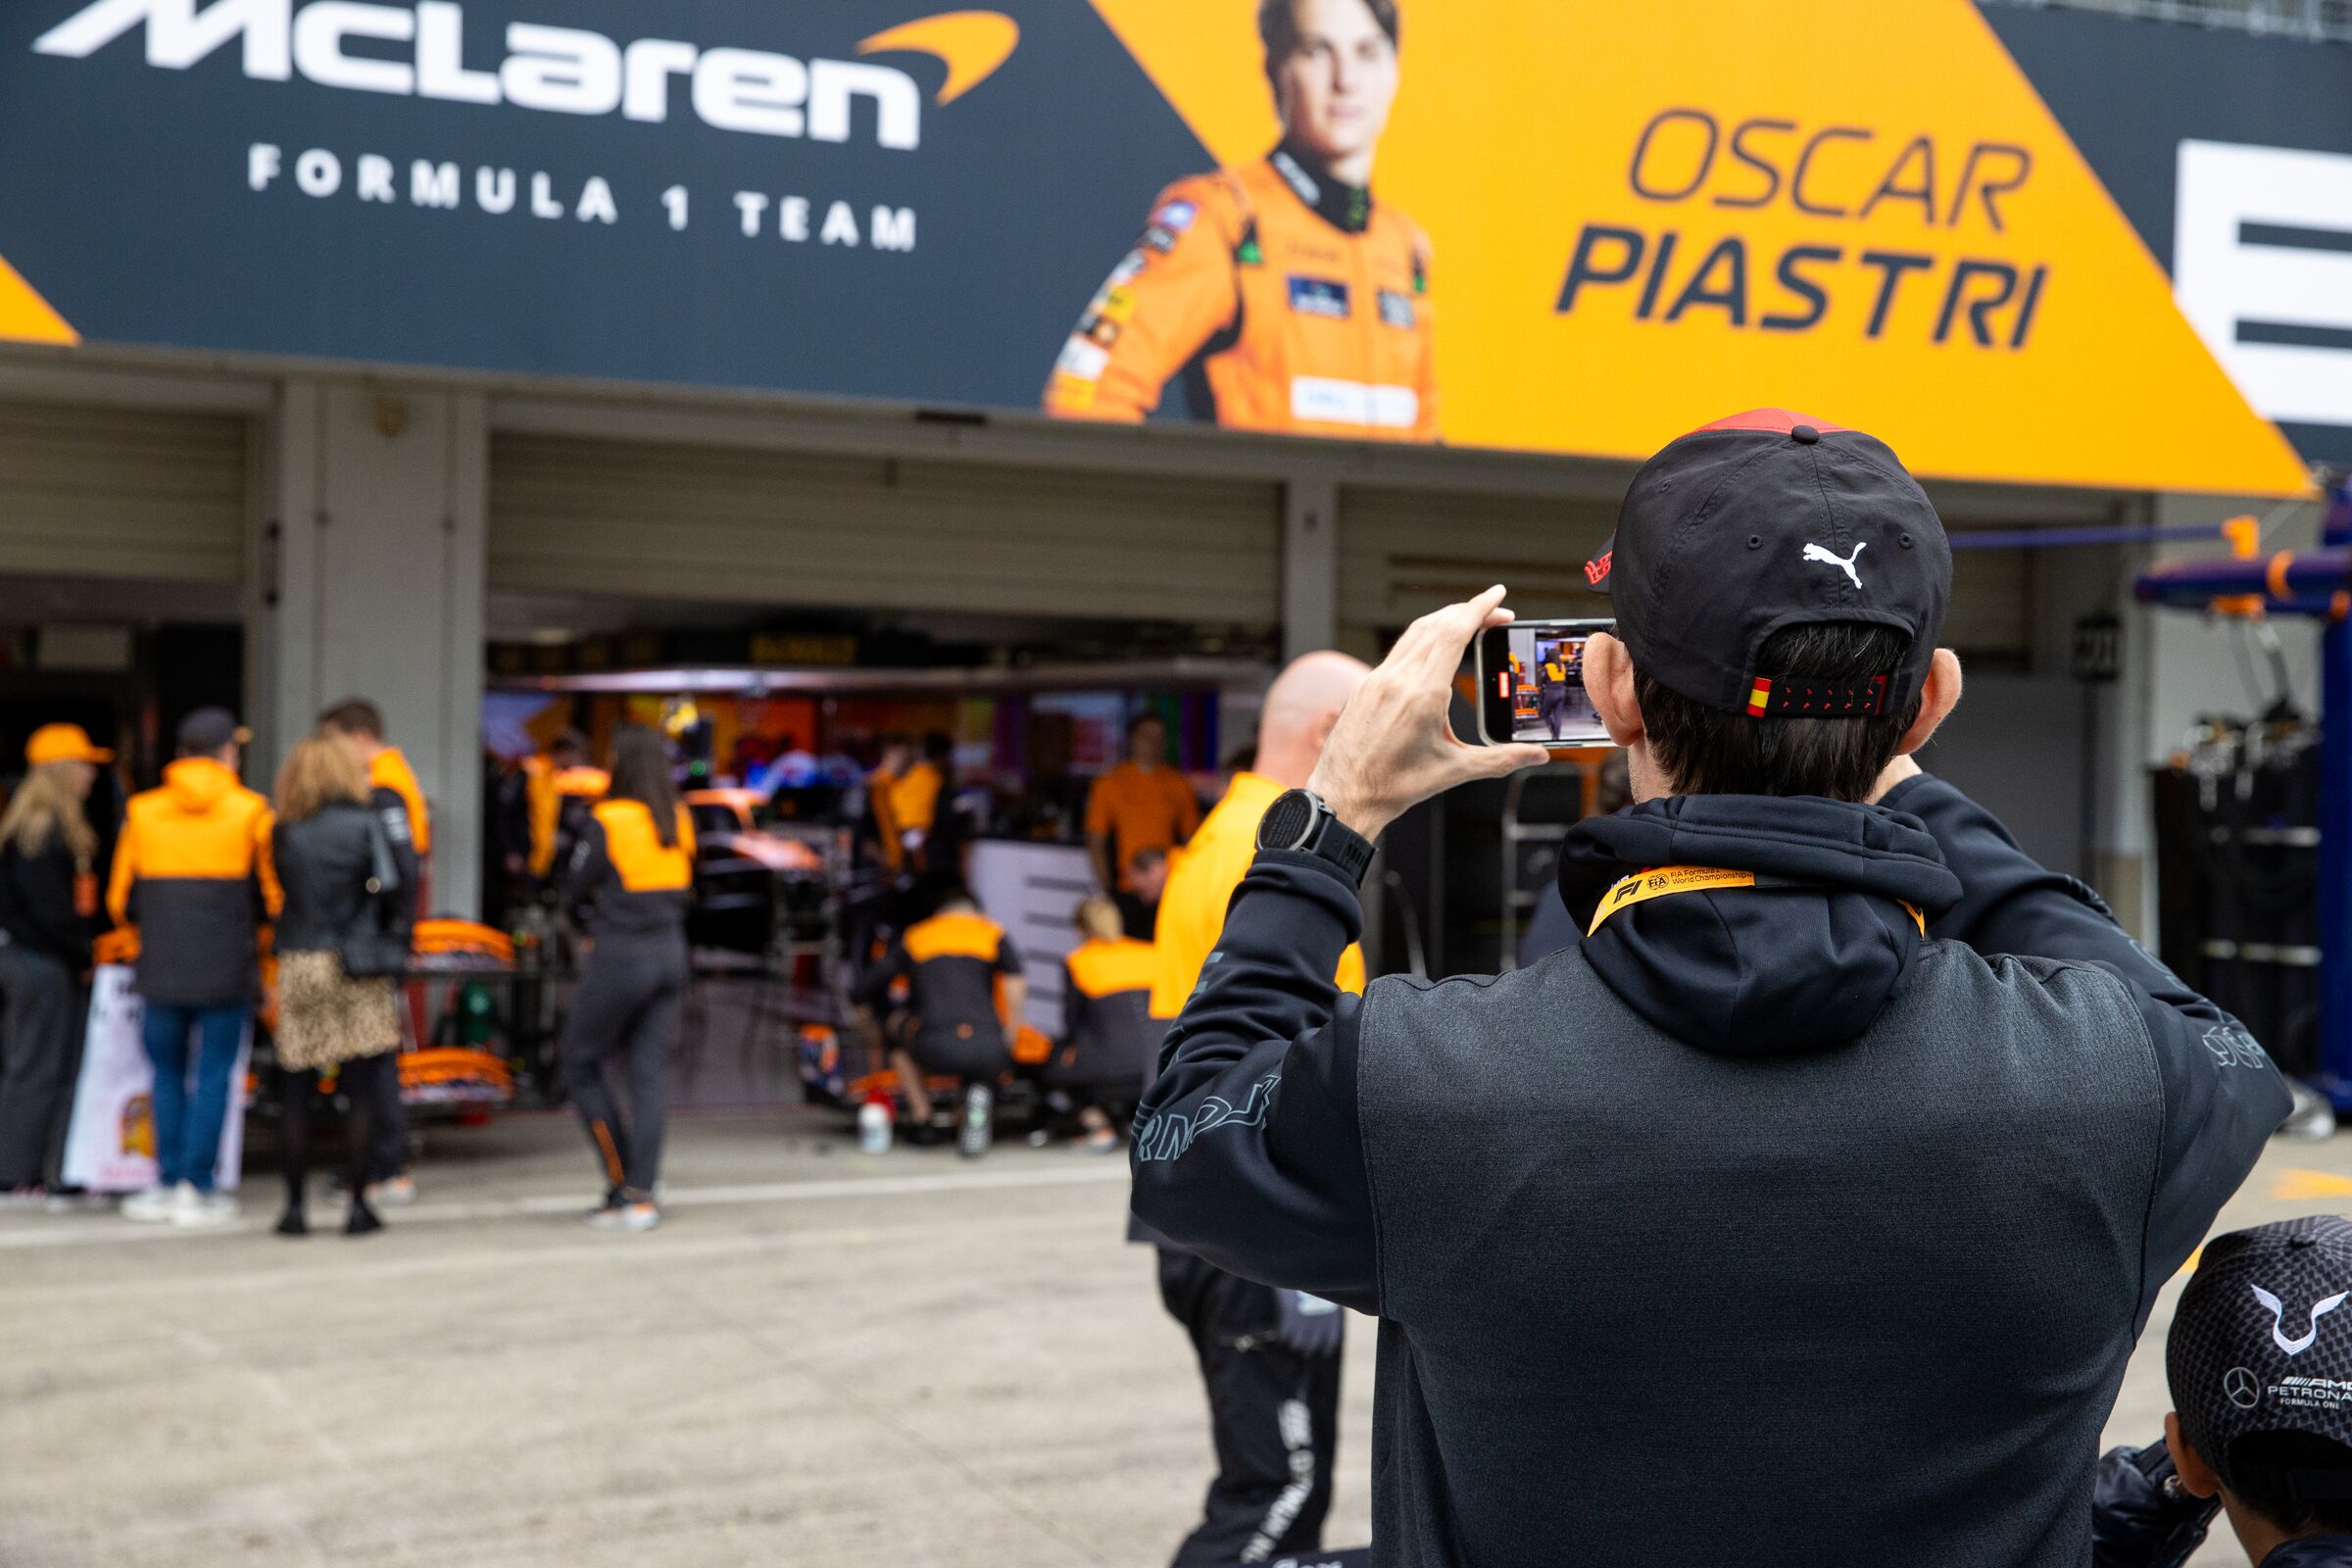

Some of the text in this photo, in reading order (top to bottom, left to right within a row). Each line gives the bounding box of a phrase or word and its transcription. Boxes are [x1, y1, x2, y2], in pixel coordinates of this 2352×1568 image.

[33, 0, 920, 151] McLaren
[248, 143, 916, 252] FORMULA 1 TEAM
[1628, 108, 2032, 232] OSCAR
[1554, 223, 2047, 350] PIASTRI
[1670, 870, 1683, 879] FIA
[1684, 867, 1714, 877] Formula
[1672, 870, 1747, 885] World Championship
[2280, 1397, 2340, 1409] FORMULA ONE
